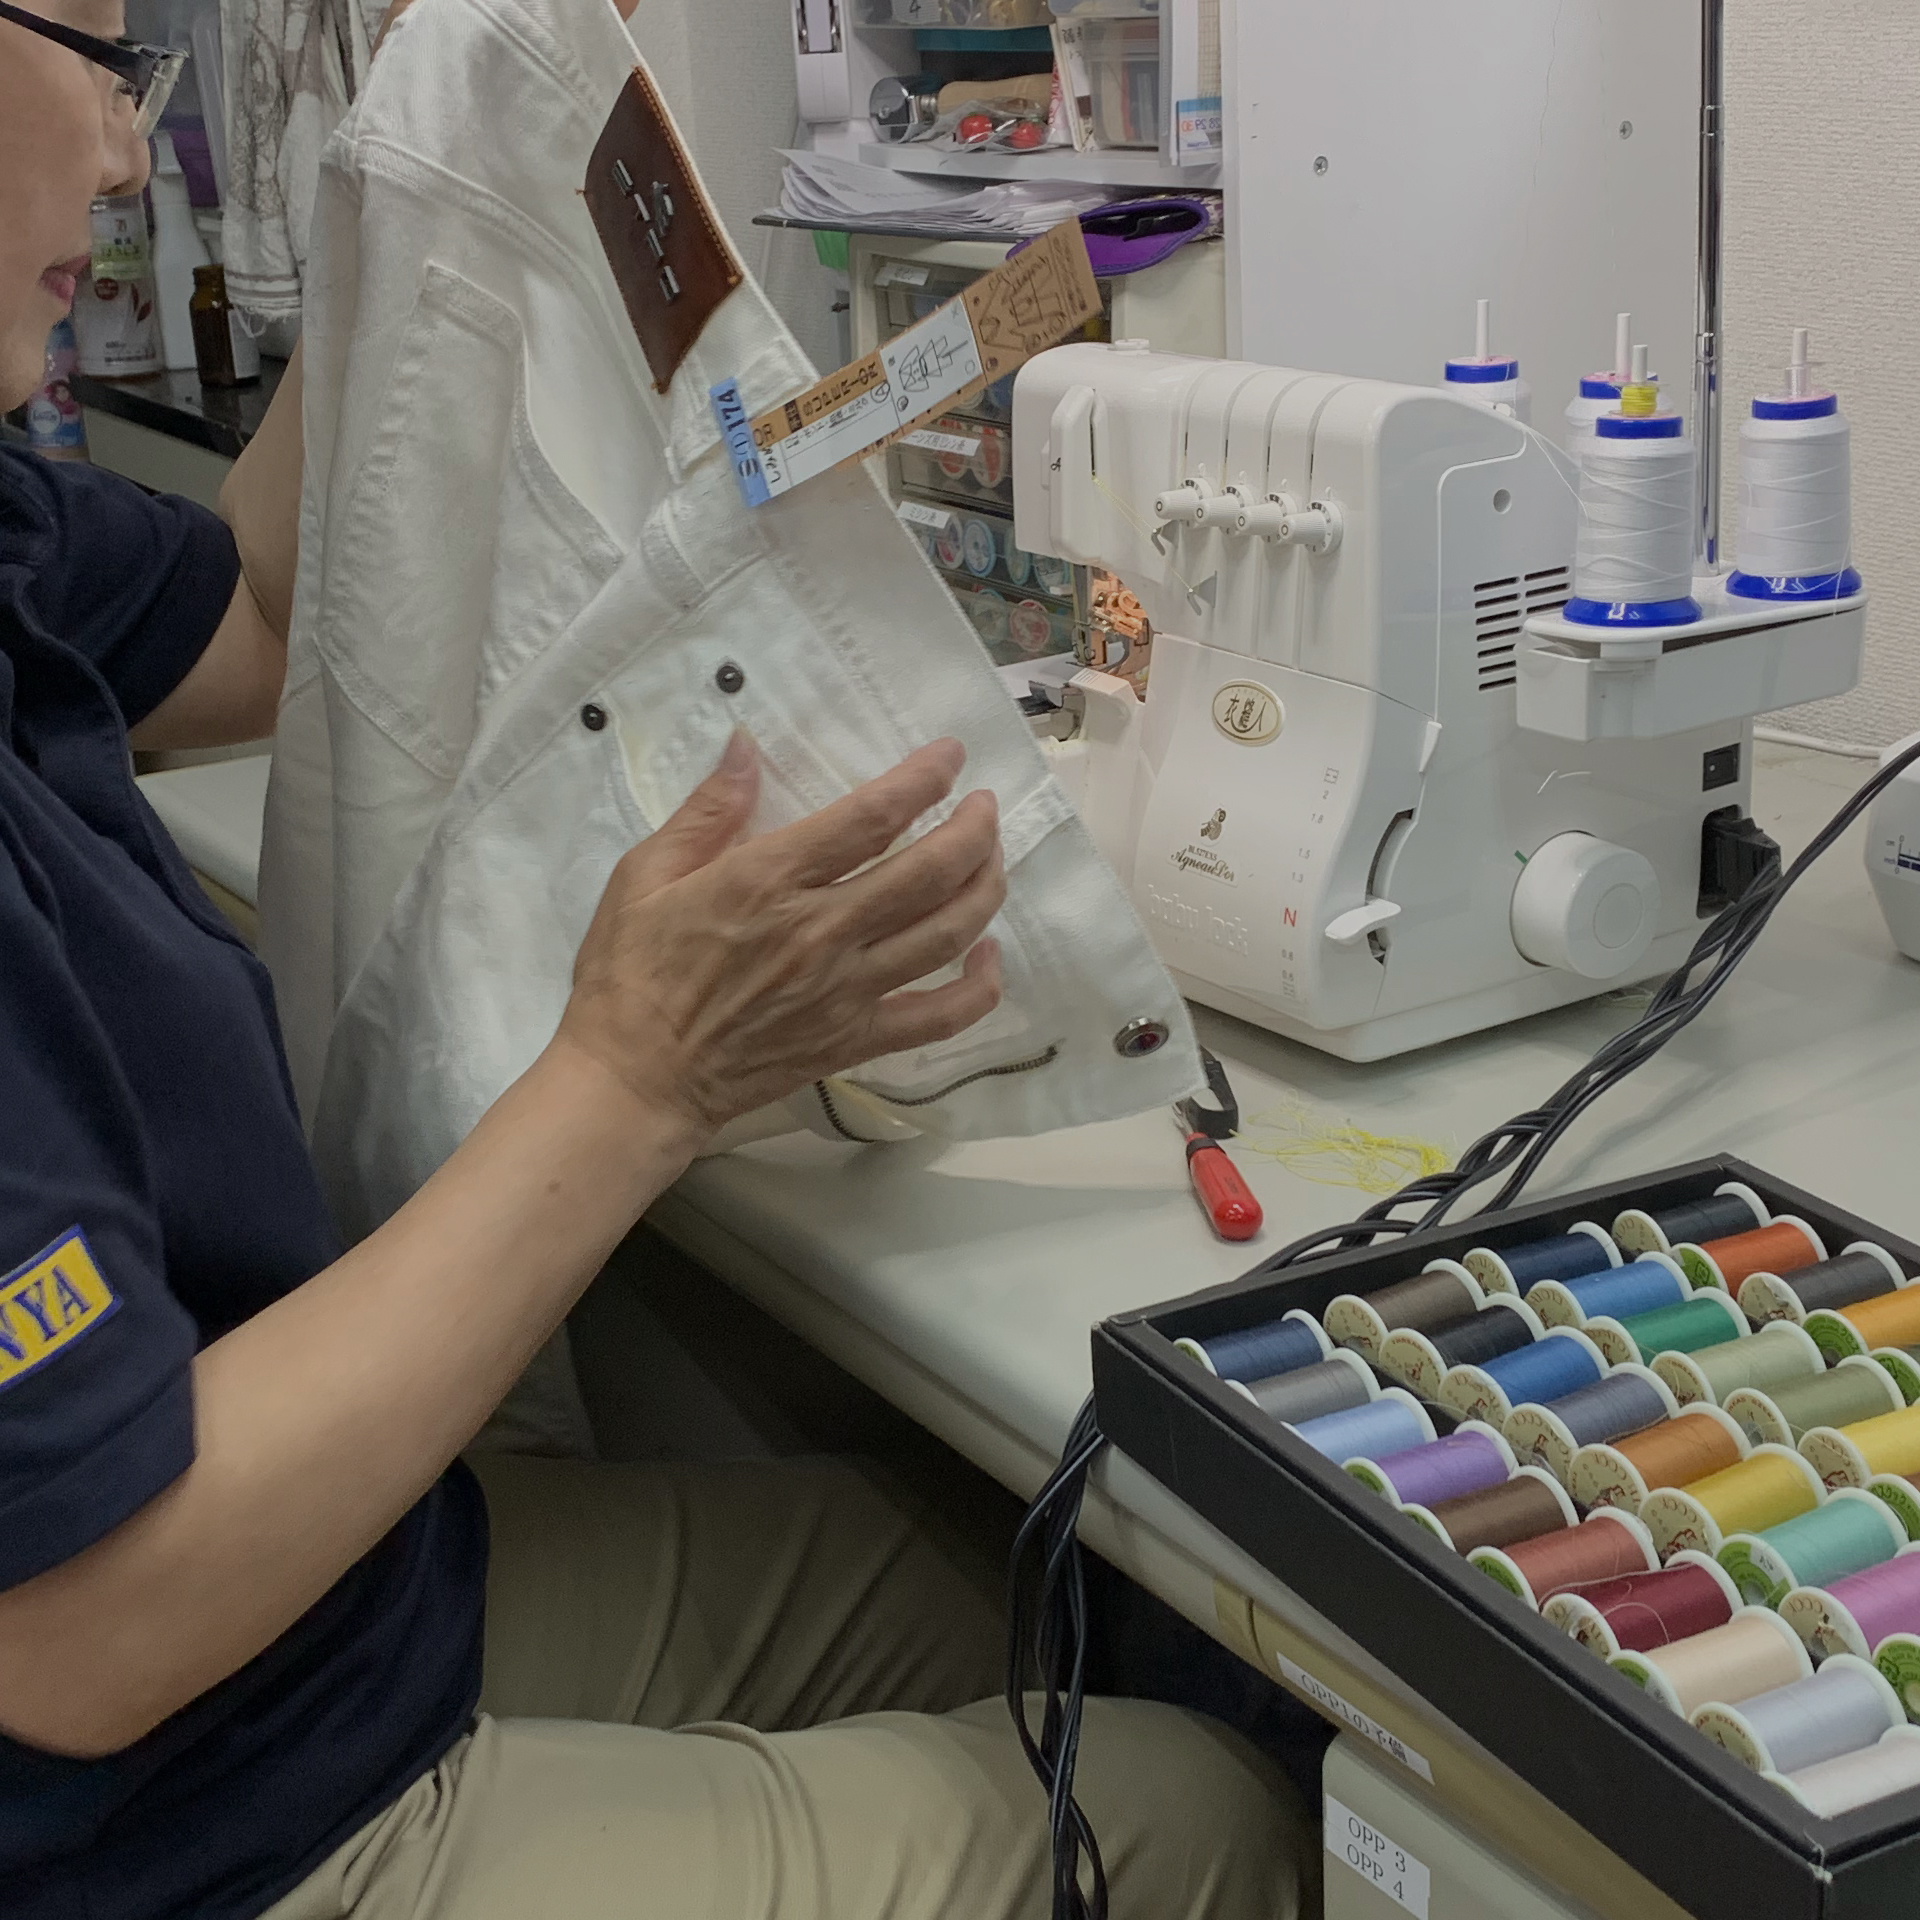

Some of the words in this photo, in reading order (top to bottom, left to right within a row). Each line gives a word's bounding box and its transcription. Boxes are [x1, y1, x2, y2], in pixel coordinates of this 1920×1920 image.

[717, 388, 747, 433] 174
[1283, 907, 1298, 928] N
[1347, 1816, 1386, 1854] OPP
[1394, 1850, 1406, 1874] 3
[1346, 1843, 1385, 1882] OPP
[1392, 1880, 1405, 1901] 4
